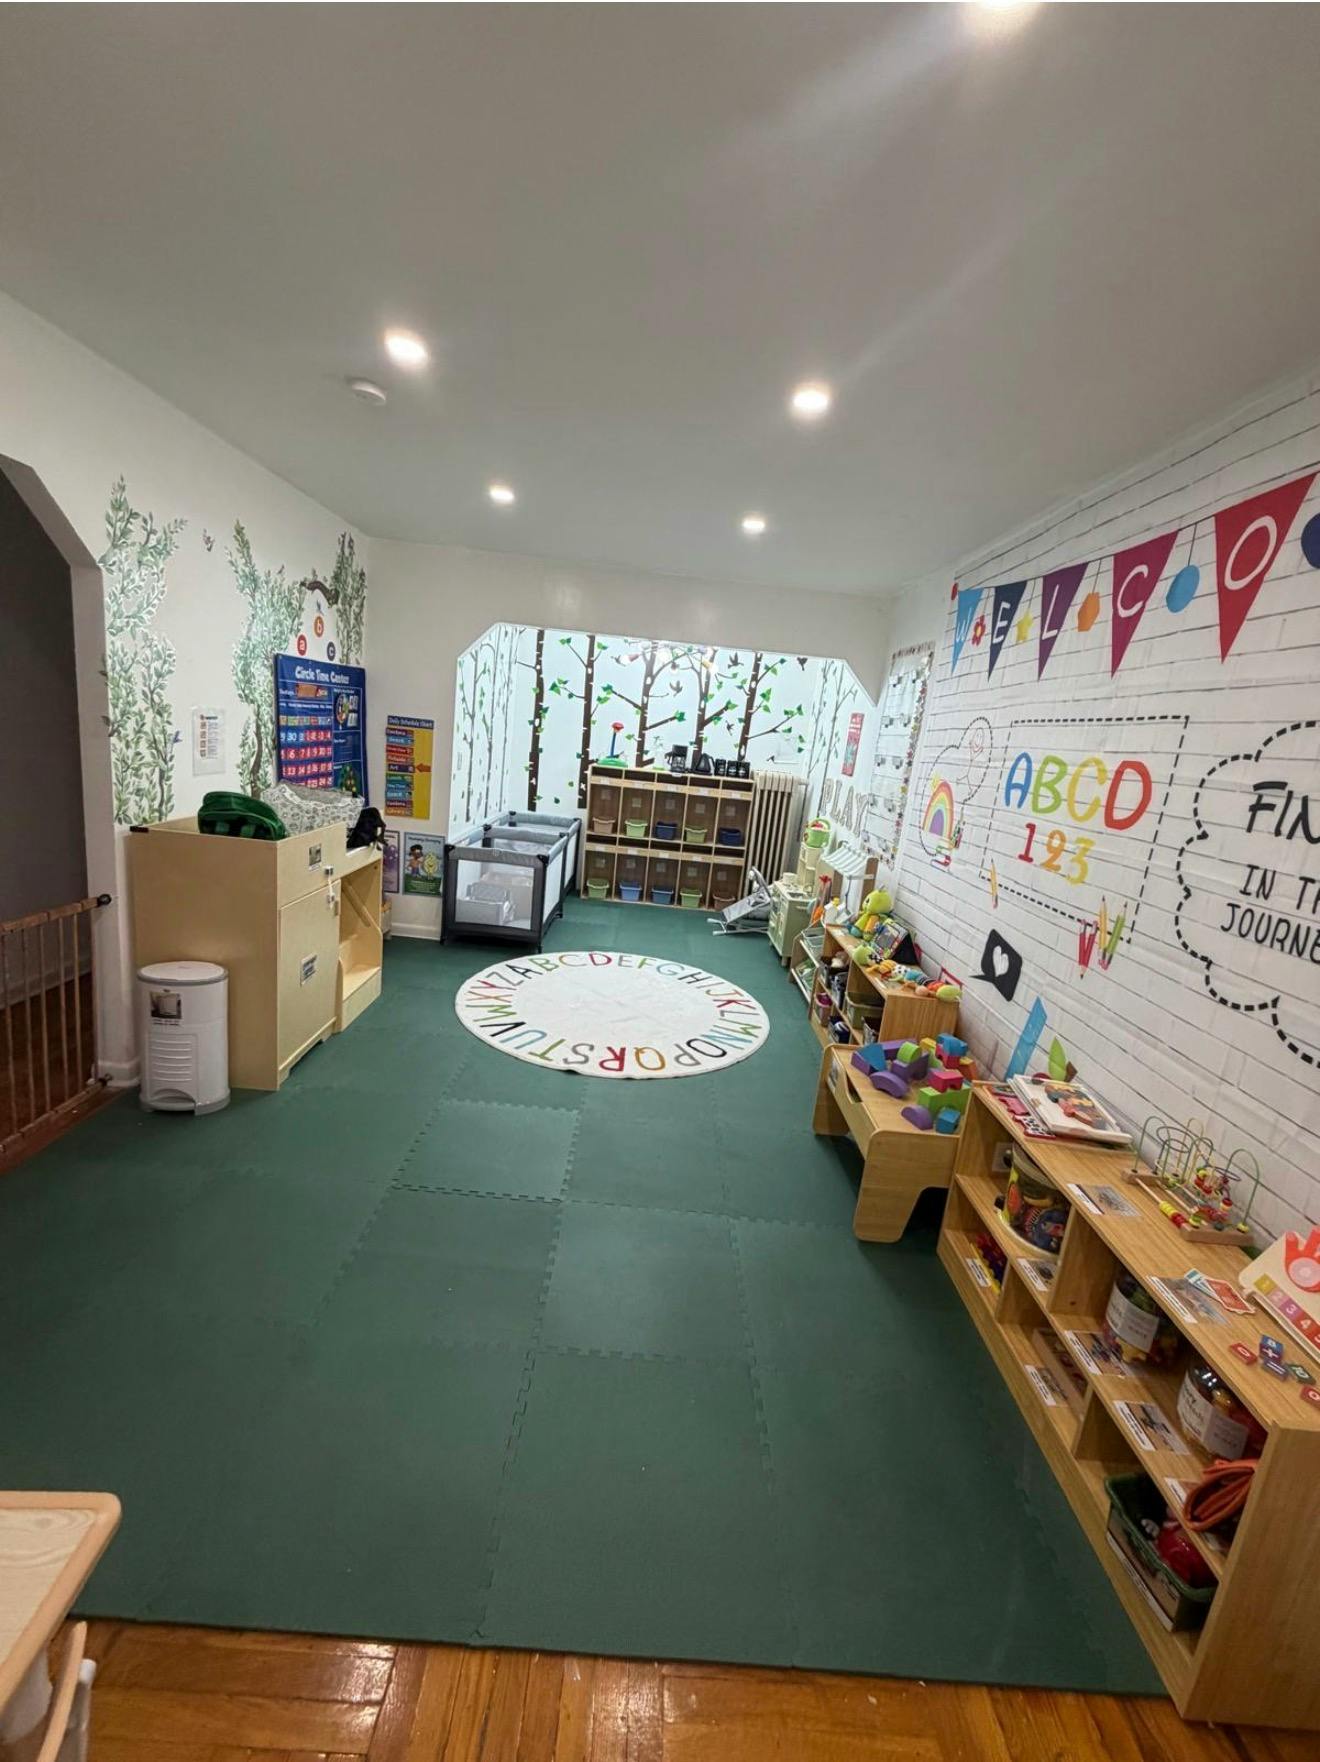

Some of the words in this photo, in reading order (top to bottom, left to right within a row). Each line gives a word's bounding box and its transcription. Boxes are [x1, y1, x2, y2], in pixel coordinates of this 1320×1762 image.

[295, 665, 315, 680] Circle
[315, 669, 330, 682] Time
[330, 671, 350, 685] Center
[821, 778, 869, 839] PLAY
[1005, 752, 1152, 831] ABCD
[1239, 864, 1277, 901] IN
